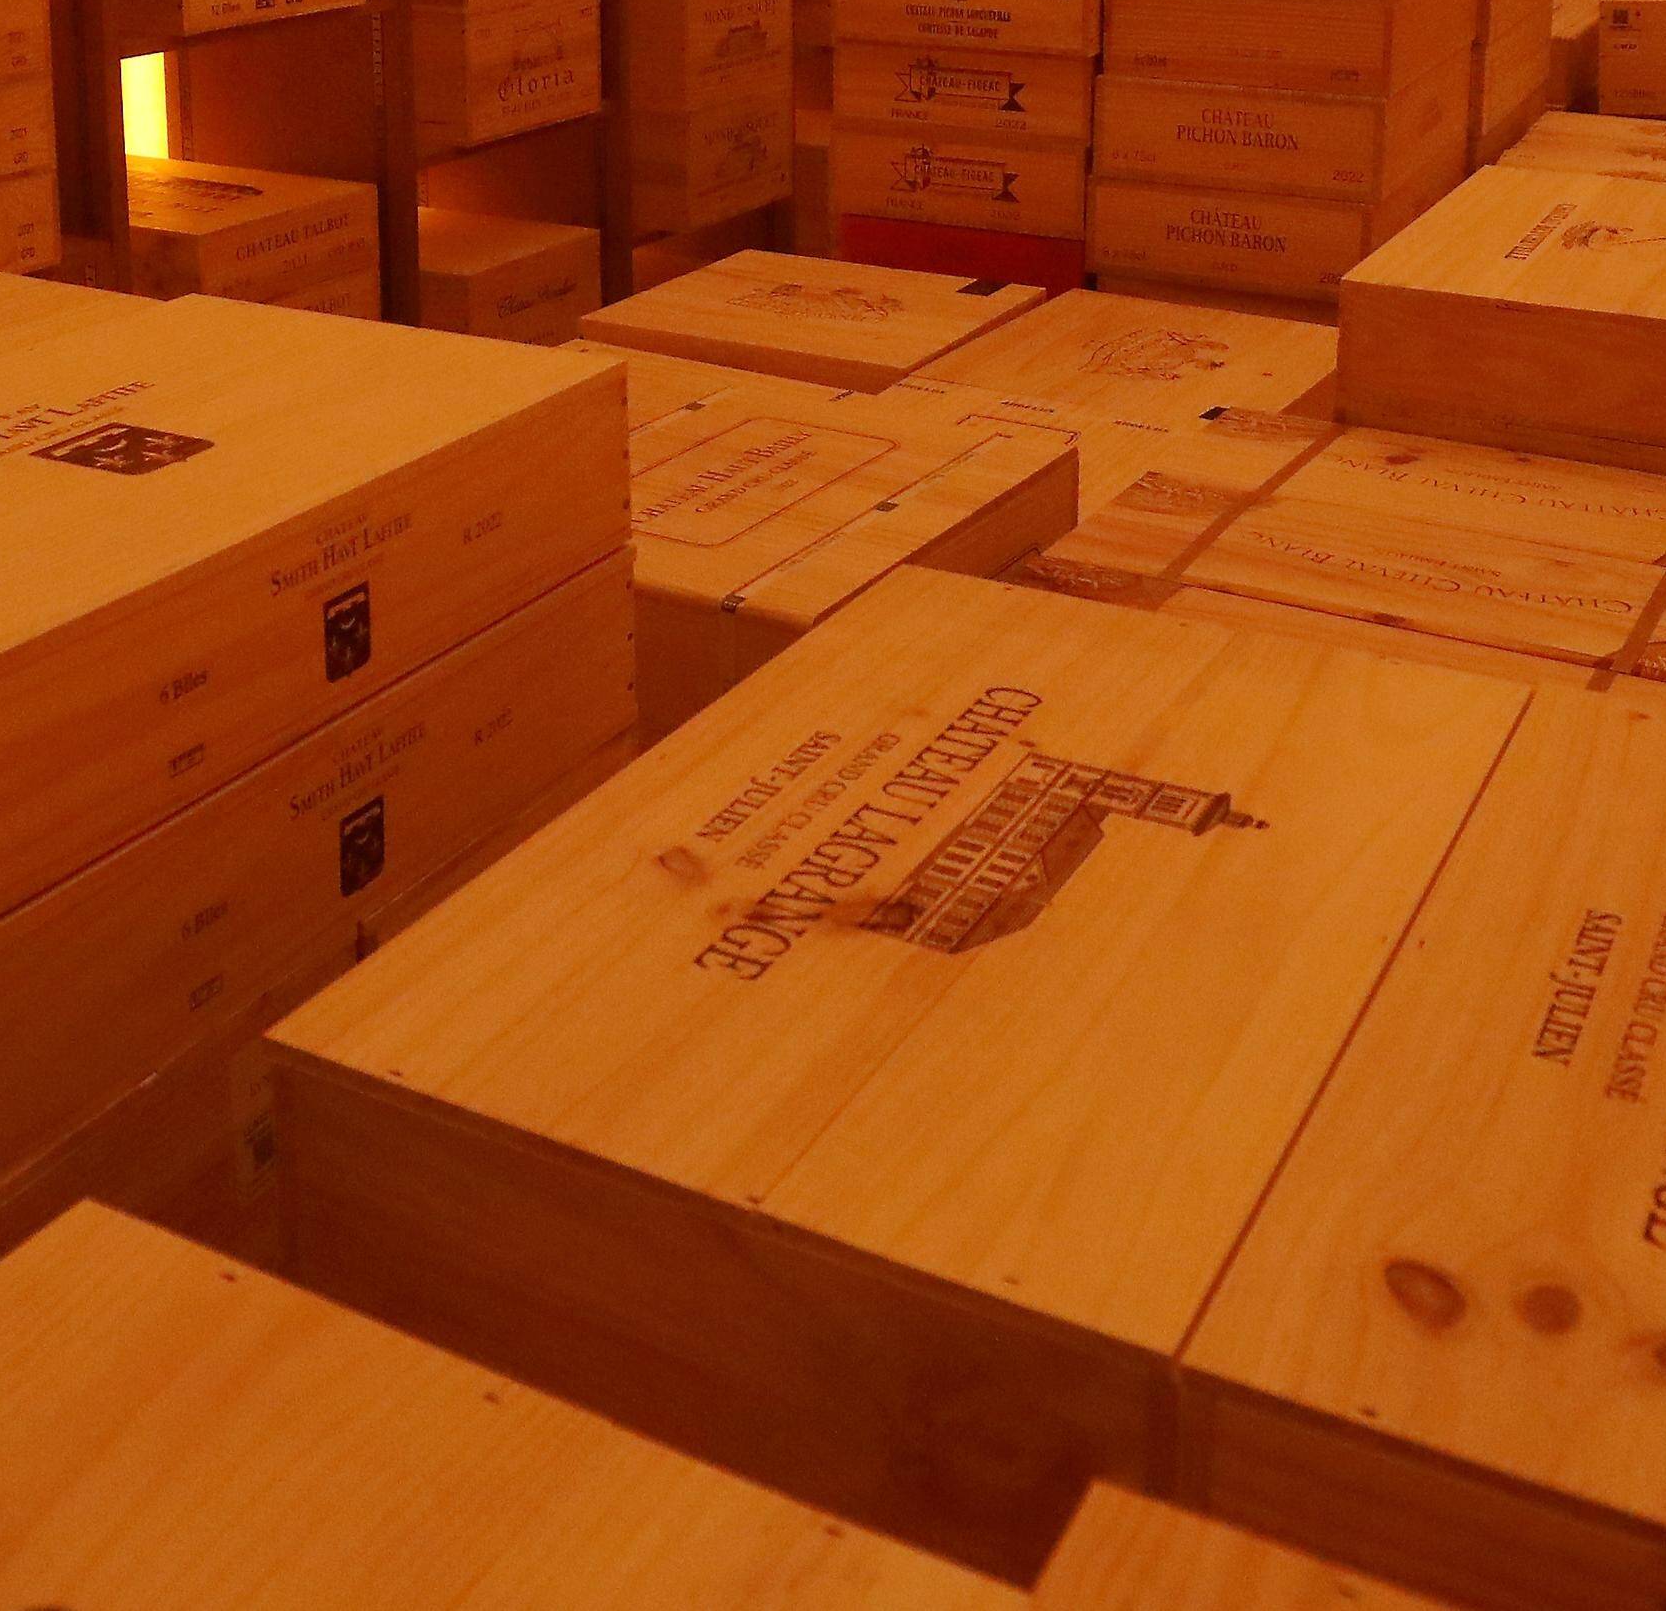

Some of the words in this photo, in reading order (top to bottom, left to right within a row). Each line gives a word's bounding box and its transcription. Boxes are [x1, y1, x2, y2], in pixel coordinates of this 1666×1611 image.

[1176, 124, 1238, 147] PICHON
[1242, 131, 1300, 152] BARON
[1332, 169, 1365, 185] 2022
[235, 228, 300, 262] CHATEAU
[302, 212, 350, 241] TALBOT
[1165, 224, 1228, 247] PICHON
[1231, 231, 1287, 253] BARON
[44, 379, 156, 418] LAFITTE
[1418, 475, 1527, 505] CHEVAL
[269, 561, 320, 598] SMITH
[323, 536, 361, 569] HAUT
[363, 511, 413, 551] LAFITTE
[1246, 529, 1336, 566] BLANC
[1344, 558, 1462, 594] CHEVAL
[159, 687, 170, 705] 6
[287, 778, 336, 822] SMITH
[338, 754, 374, 788] HAUT
[377, 720, 427, 763] LAFITTE
[691, 800, 903, 983] LAGRANGE
[1531, 907, 1624, 1069] SAINT-JULIEN
